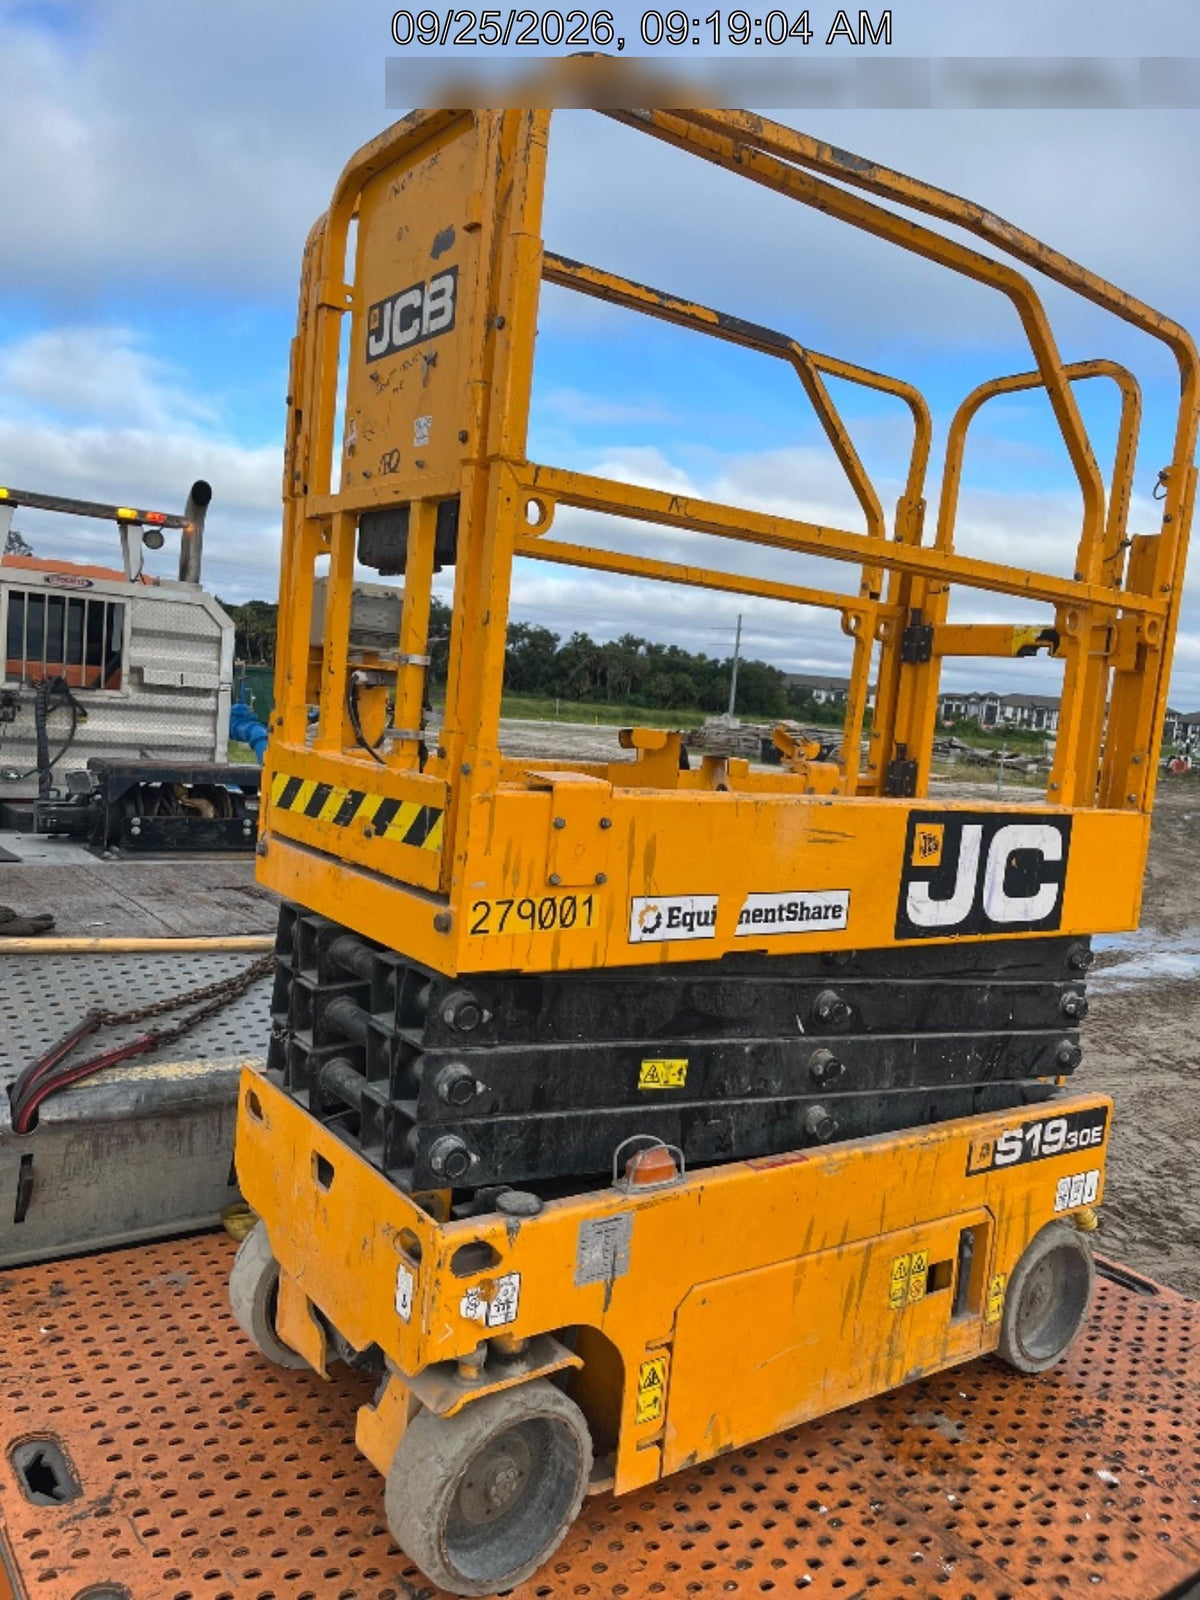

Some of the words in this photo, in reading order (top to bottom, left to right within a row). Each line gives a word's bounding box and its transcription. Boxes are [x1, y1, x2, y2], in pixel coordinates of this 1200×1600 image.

[368, 274, 455, 357] JCB
[470, 893, 593, 936] 279001
[906, 824, 1063, 927] JC
